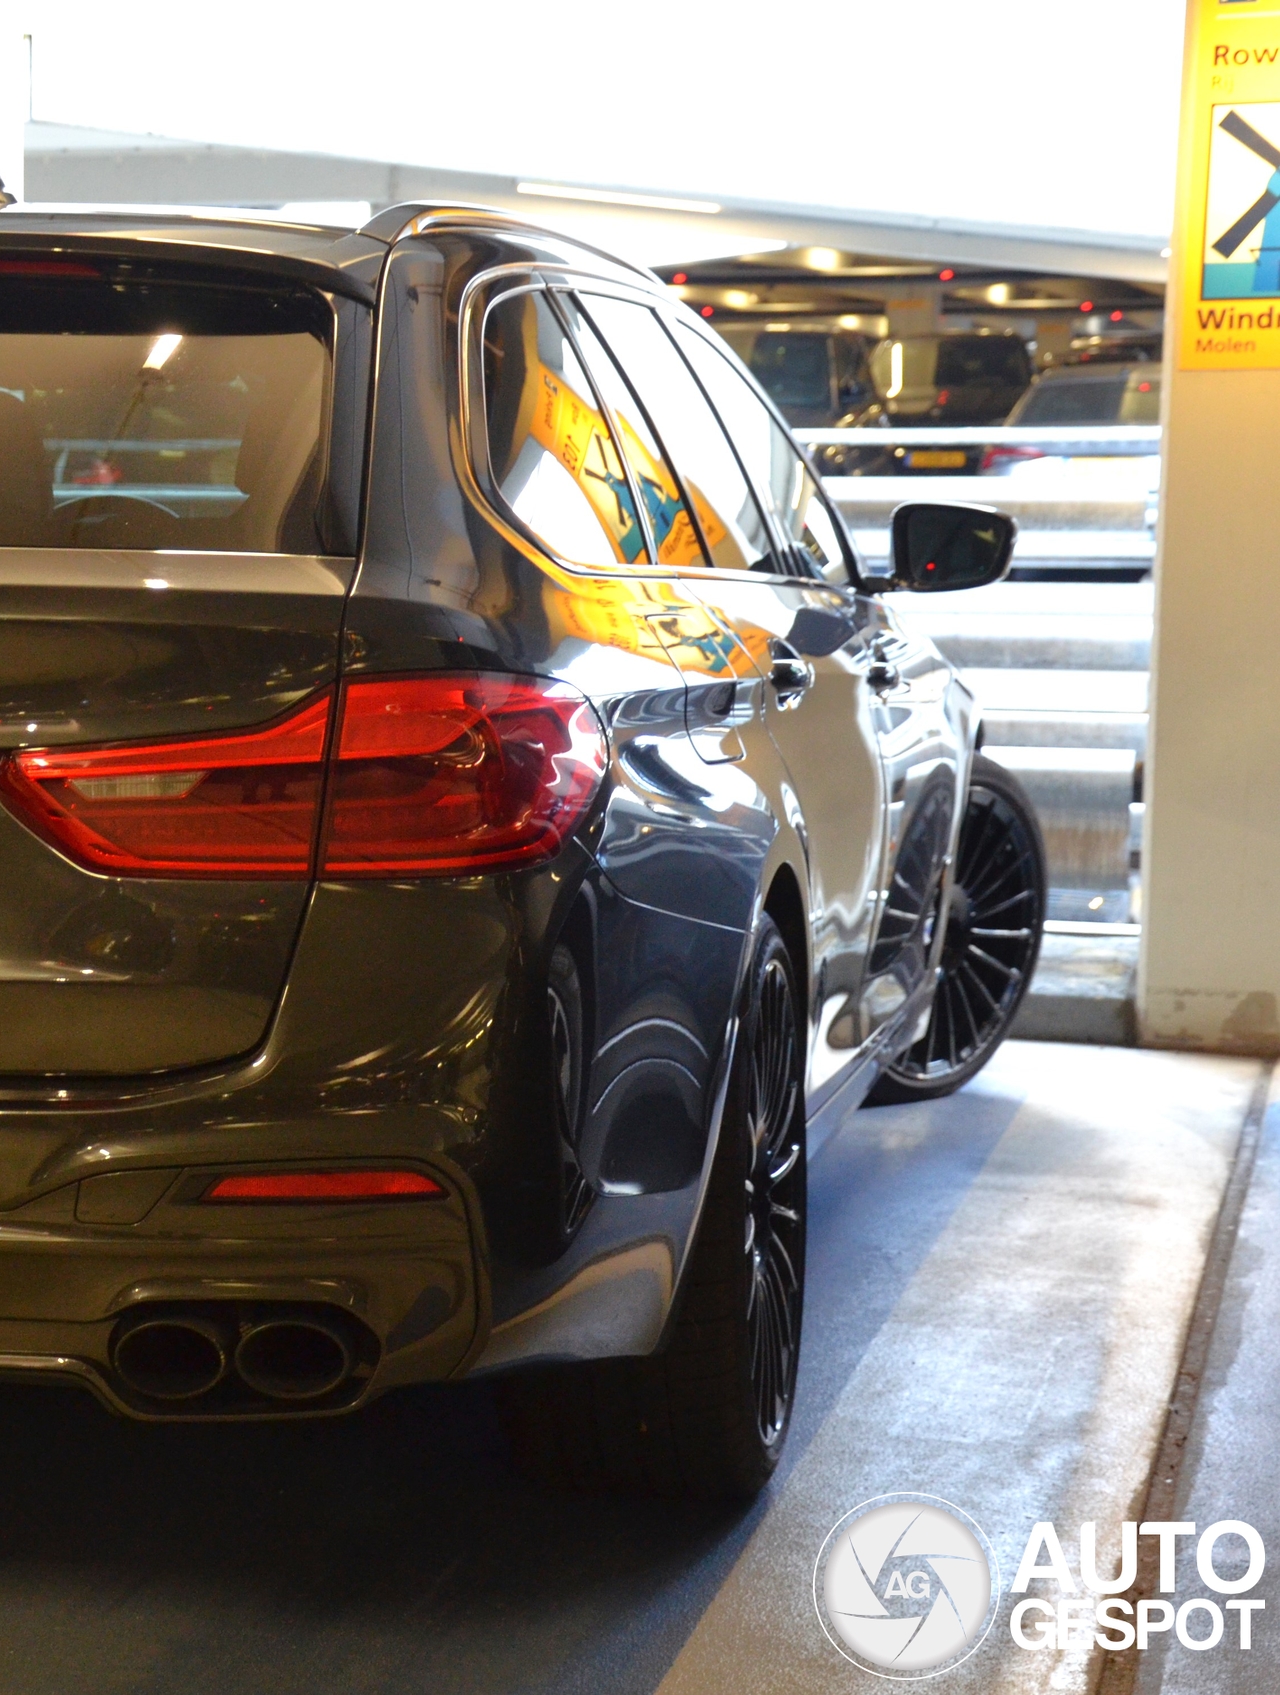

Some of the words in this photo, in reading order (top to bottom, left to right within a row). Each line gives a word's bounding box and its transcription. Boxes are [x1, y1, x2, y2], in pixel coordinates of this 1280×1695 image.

[1214, 45, 1279, 66] Row
[1197, 306, 1280, 330] Wind
[1196, 338, 1256, 353] Molen
